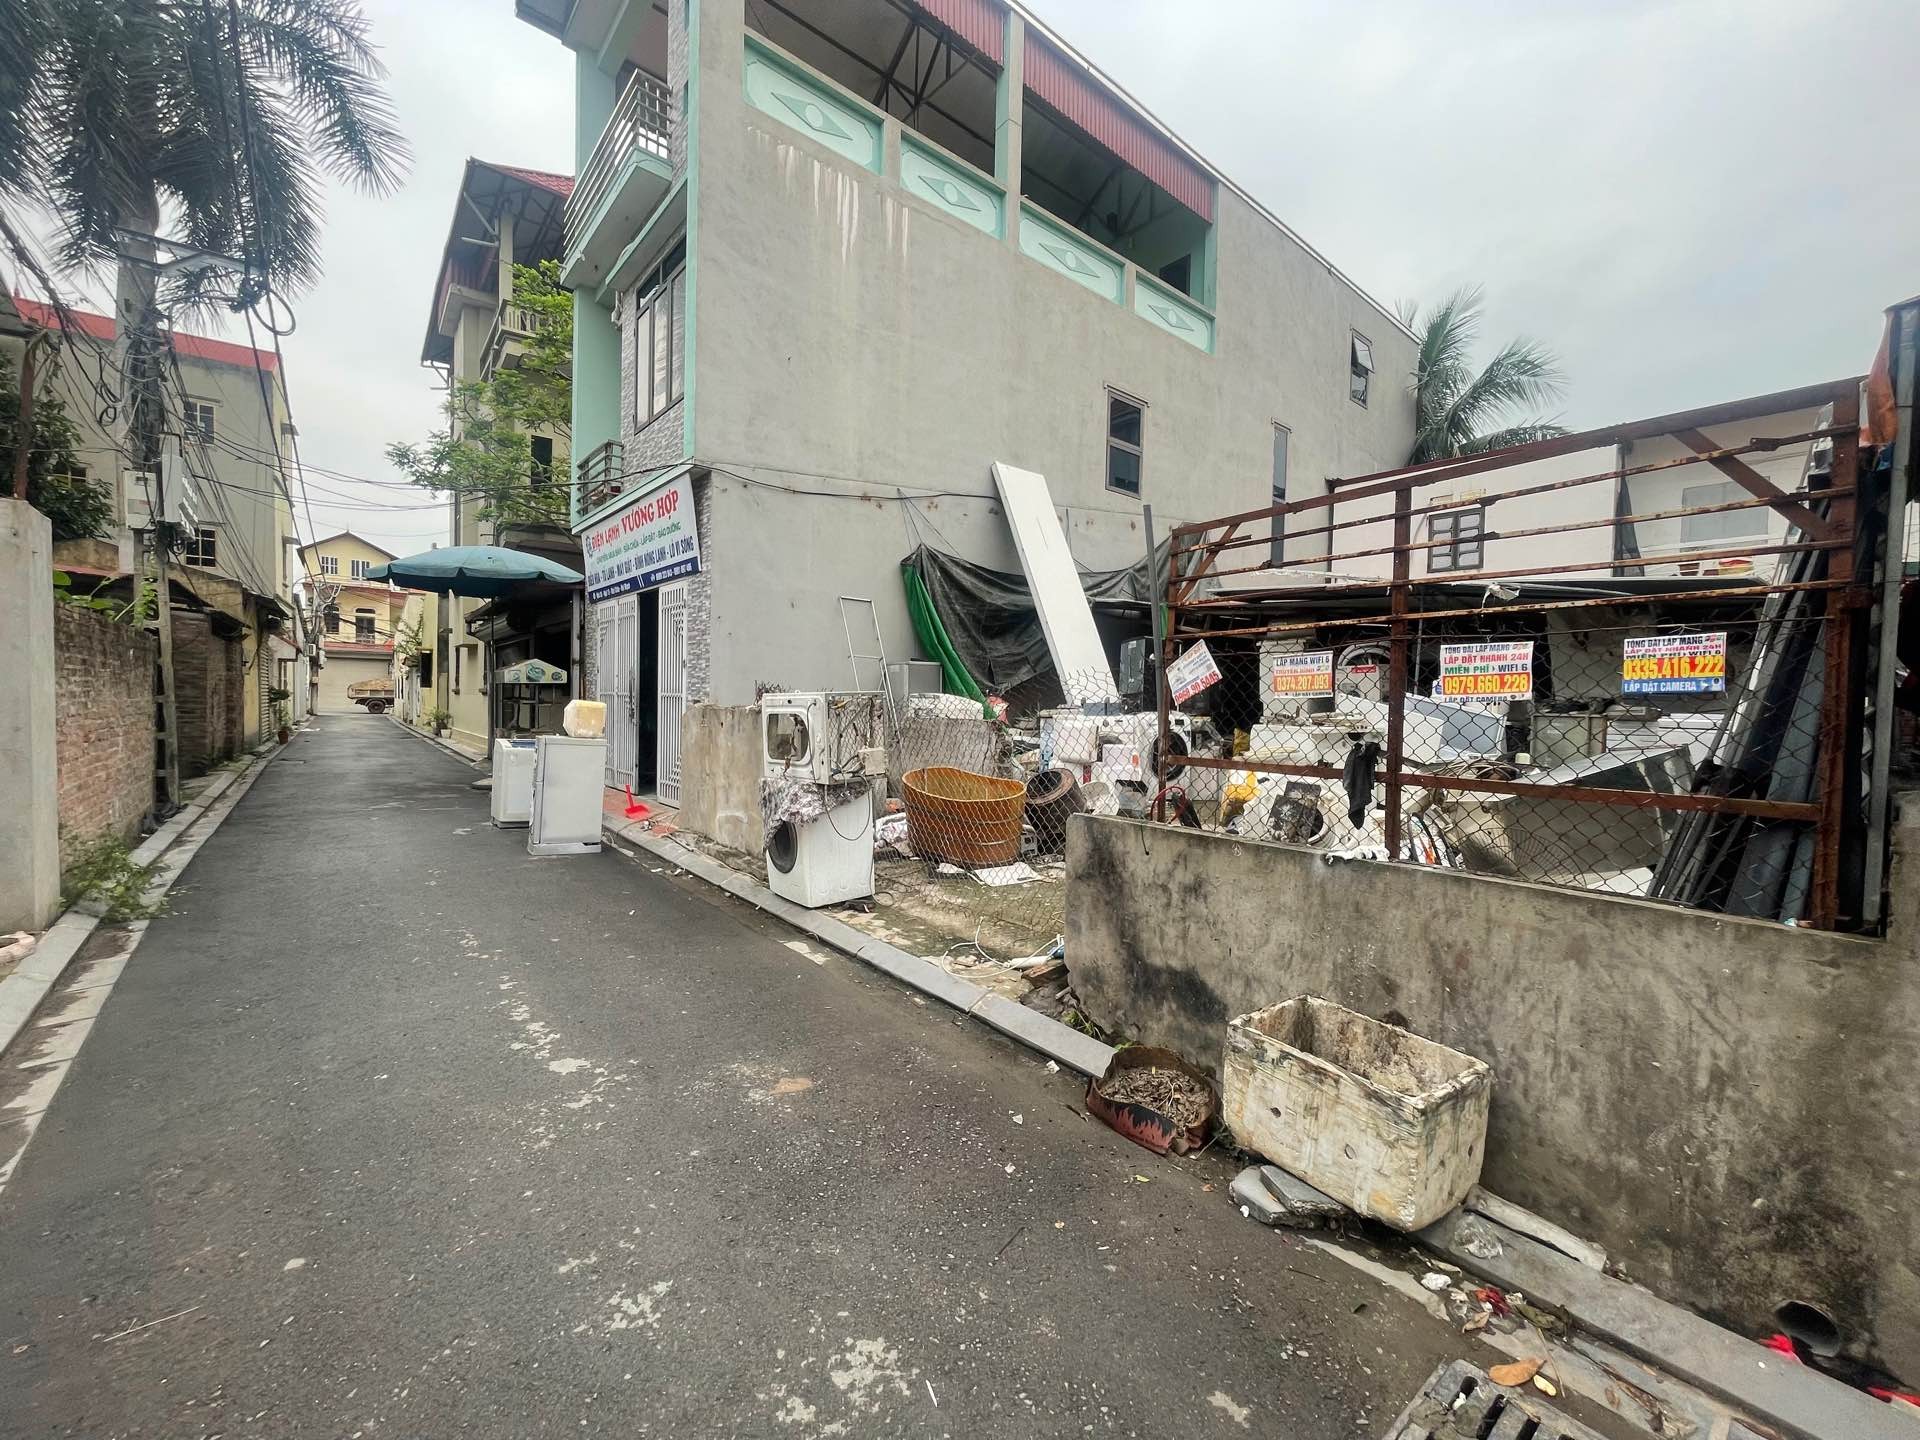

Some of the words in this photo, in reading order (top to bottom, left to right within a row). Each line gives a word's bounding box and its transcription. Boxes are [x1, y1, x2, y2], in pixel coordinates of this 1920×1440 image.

[591, 532, 604, 551] ĐIỆN
[605, 525, 620, 546] LẠNH
[621, 502, 654, 533] VƯƠNG
[656, 489, 679, 521] HỢP
[1310, 656, 1324, 664] WIFI
[1479, 653, 1507, 663] NHANH
[1510, 652, 1528, 661] 24H
[1498, 664, 1518, 672] WIFI
[1521, 663, 1528, 671] 6
[1623, 655, 1724, 680] 0335.416.222
[1276, 674, 1329, 691] 0374.207.093
[1444, 674, 1528, 694] 0979.660.228
[1624, 680, 1641, 692] LẮP
[1643, 681, 1658, 693] ĐẶT
[1660, 681, 1696, 691] CAMERA
